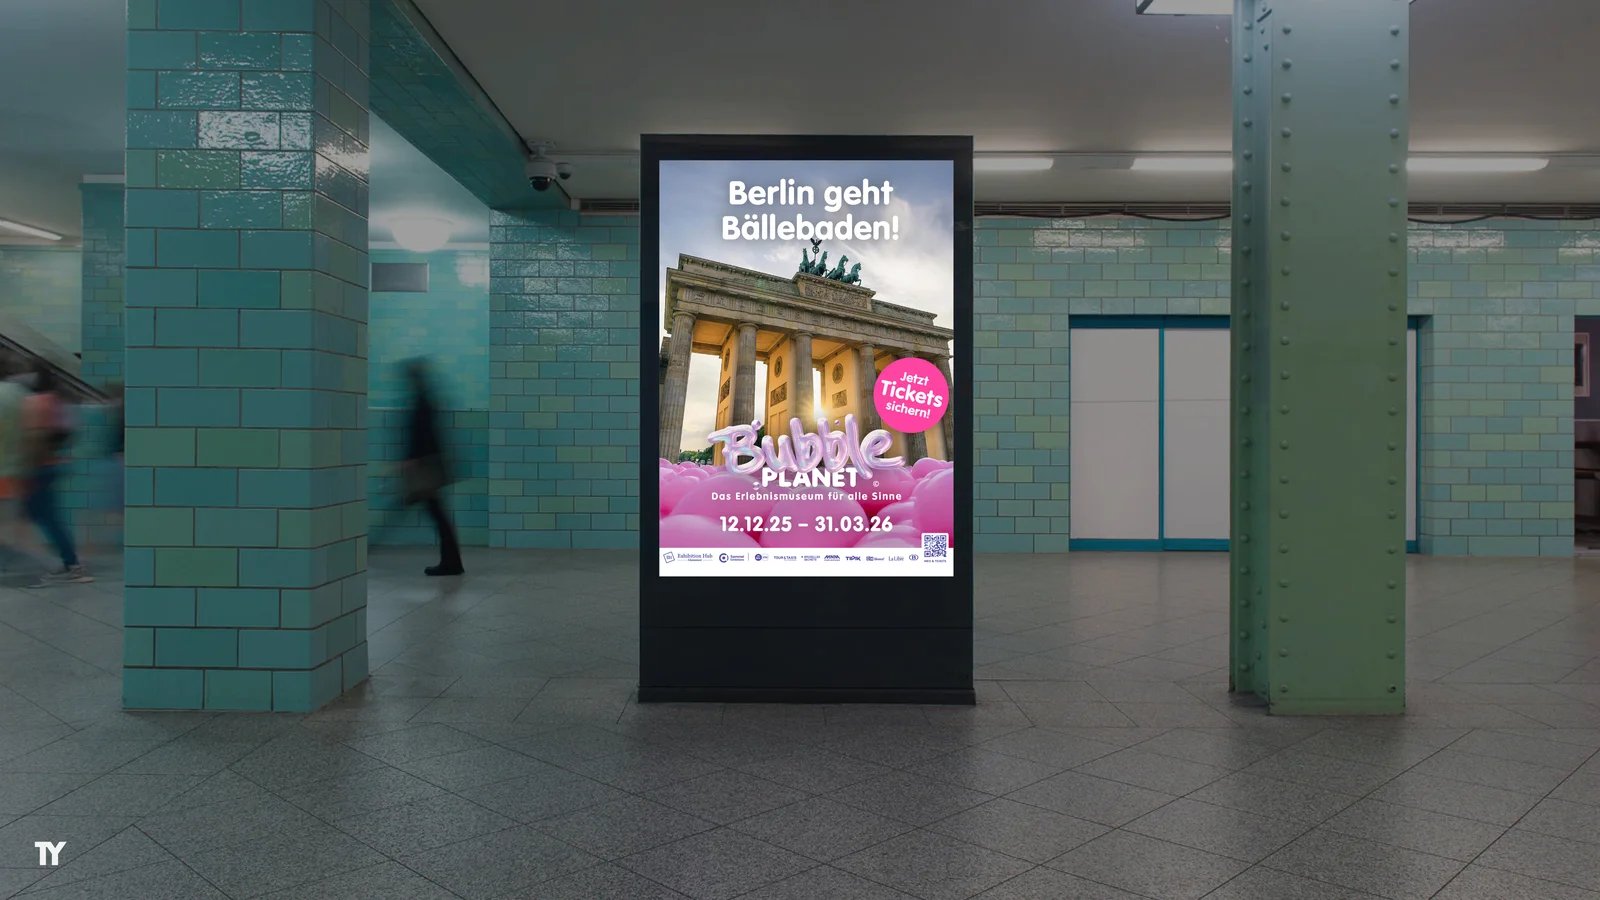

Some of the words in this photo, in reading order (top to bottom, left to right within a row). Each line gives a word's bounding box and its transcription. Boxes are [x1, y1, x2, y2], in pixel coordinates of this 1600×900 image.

[729, 178, 815, 206] Berlin
[823, 178, 894, 212] geht
[722, 213, 899, 241] Bällebaden!
[900, 371, 930, 386] Jetzt
[881, 379, 943, 407] Tickets
[885, 400, 931, 419] sichern!
[707, 413, 906, 480] Bubble
[761, 466, 858, 488] PLANET
[711, 492, 732, 501] Das
[735, 491, 824, 501] Erlebnismuseum
[827, 491, 843, 501] für
[848, 491, 867, 501] alle
[872, 491, 902, 501] Sinne
[719, 516, 792, 532] 12.12.25
[814, 516, 893, 532] 31.03.26
